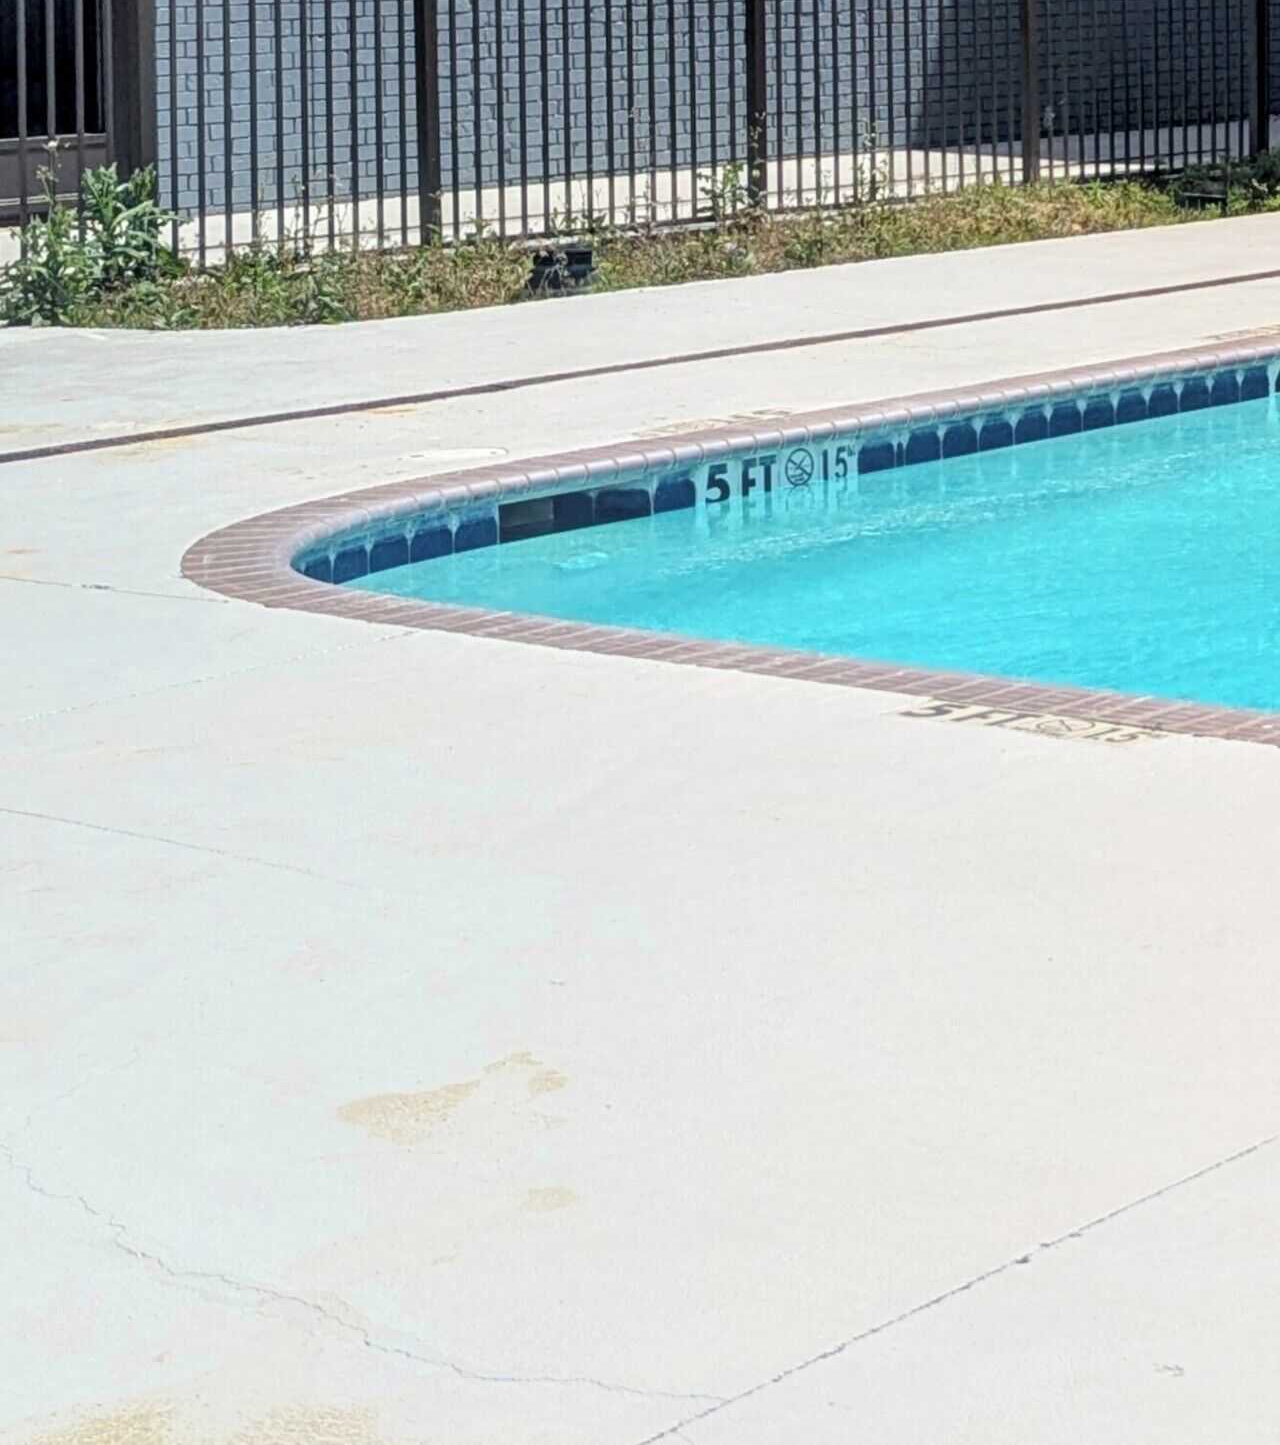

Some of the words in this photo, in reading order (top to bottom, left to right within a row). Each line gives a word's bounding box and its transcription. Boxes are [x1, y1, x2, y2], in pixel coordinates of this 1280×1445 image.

[705, 463, 731, 504] 5
[741, 454, 777, 497] FT
[898, 703, 967, 718] 5
